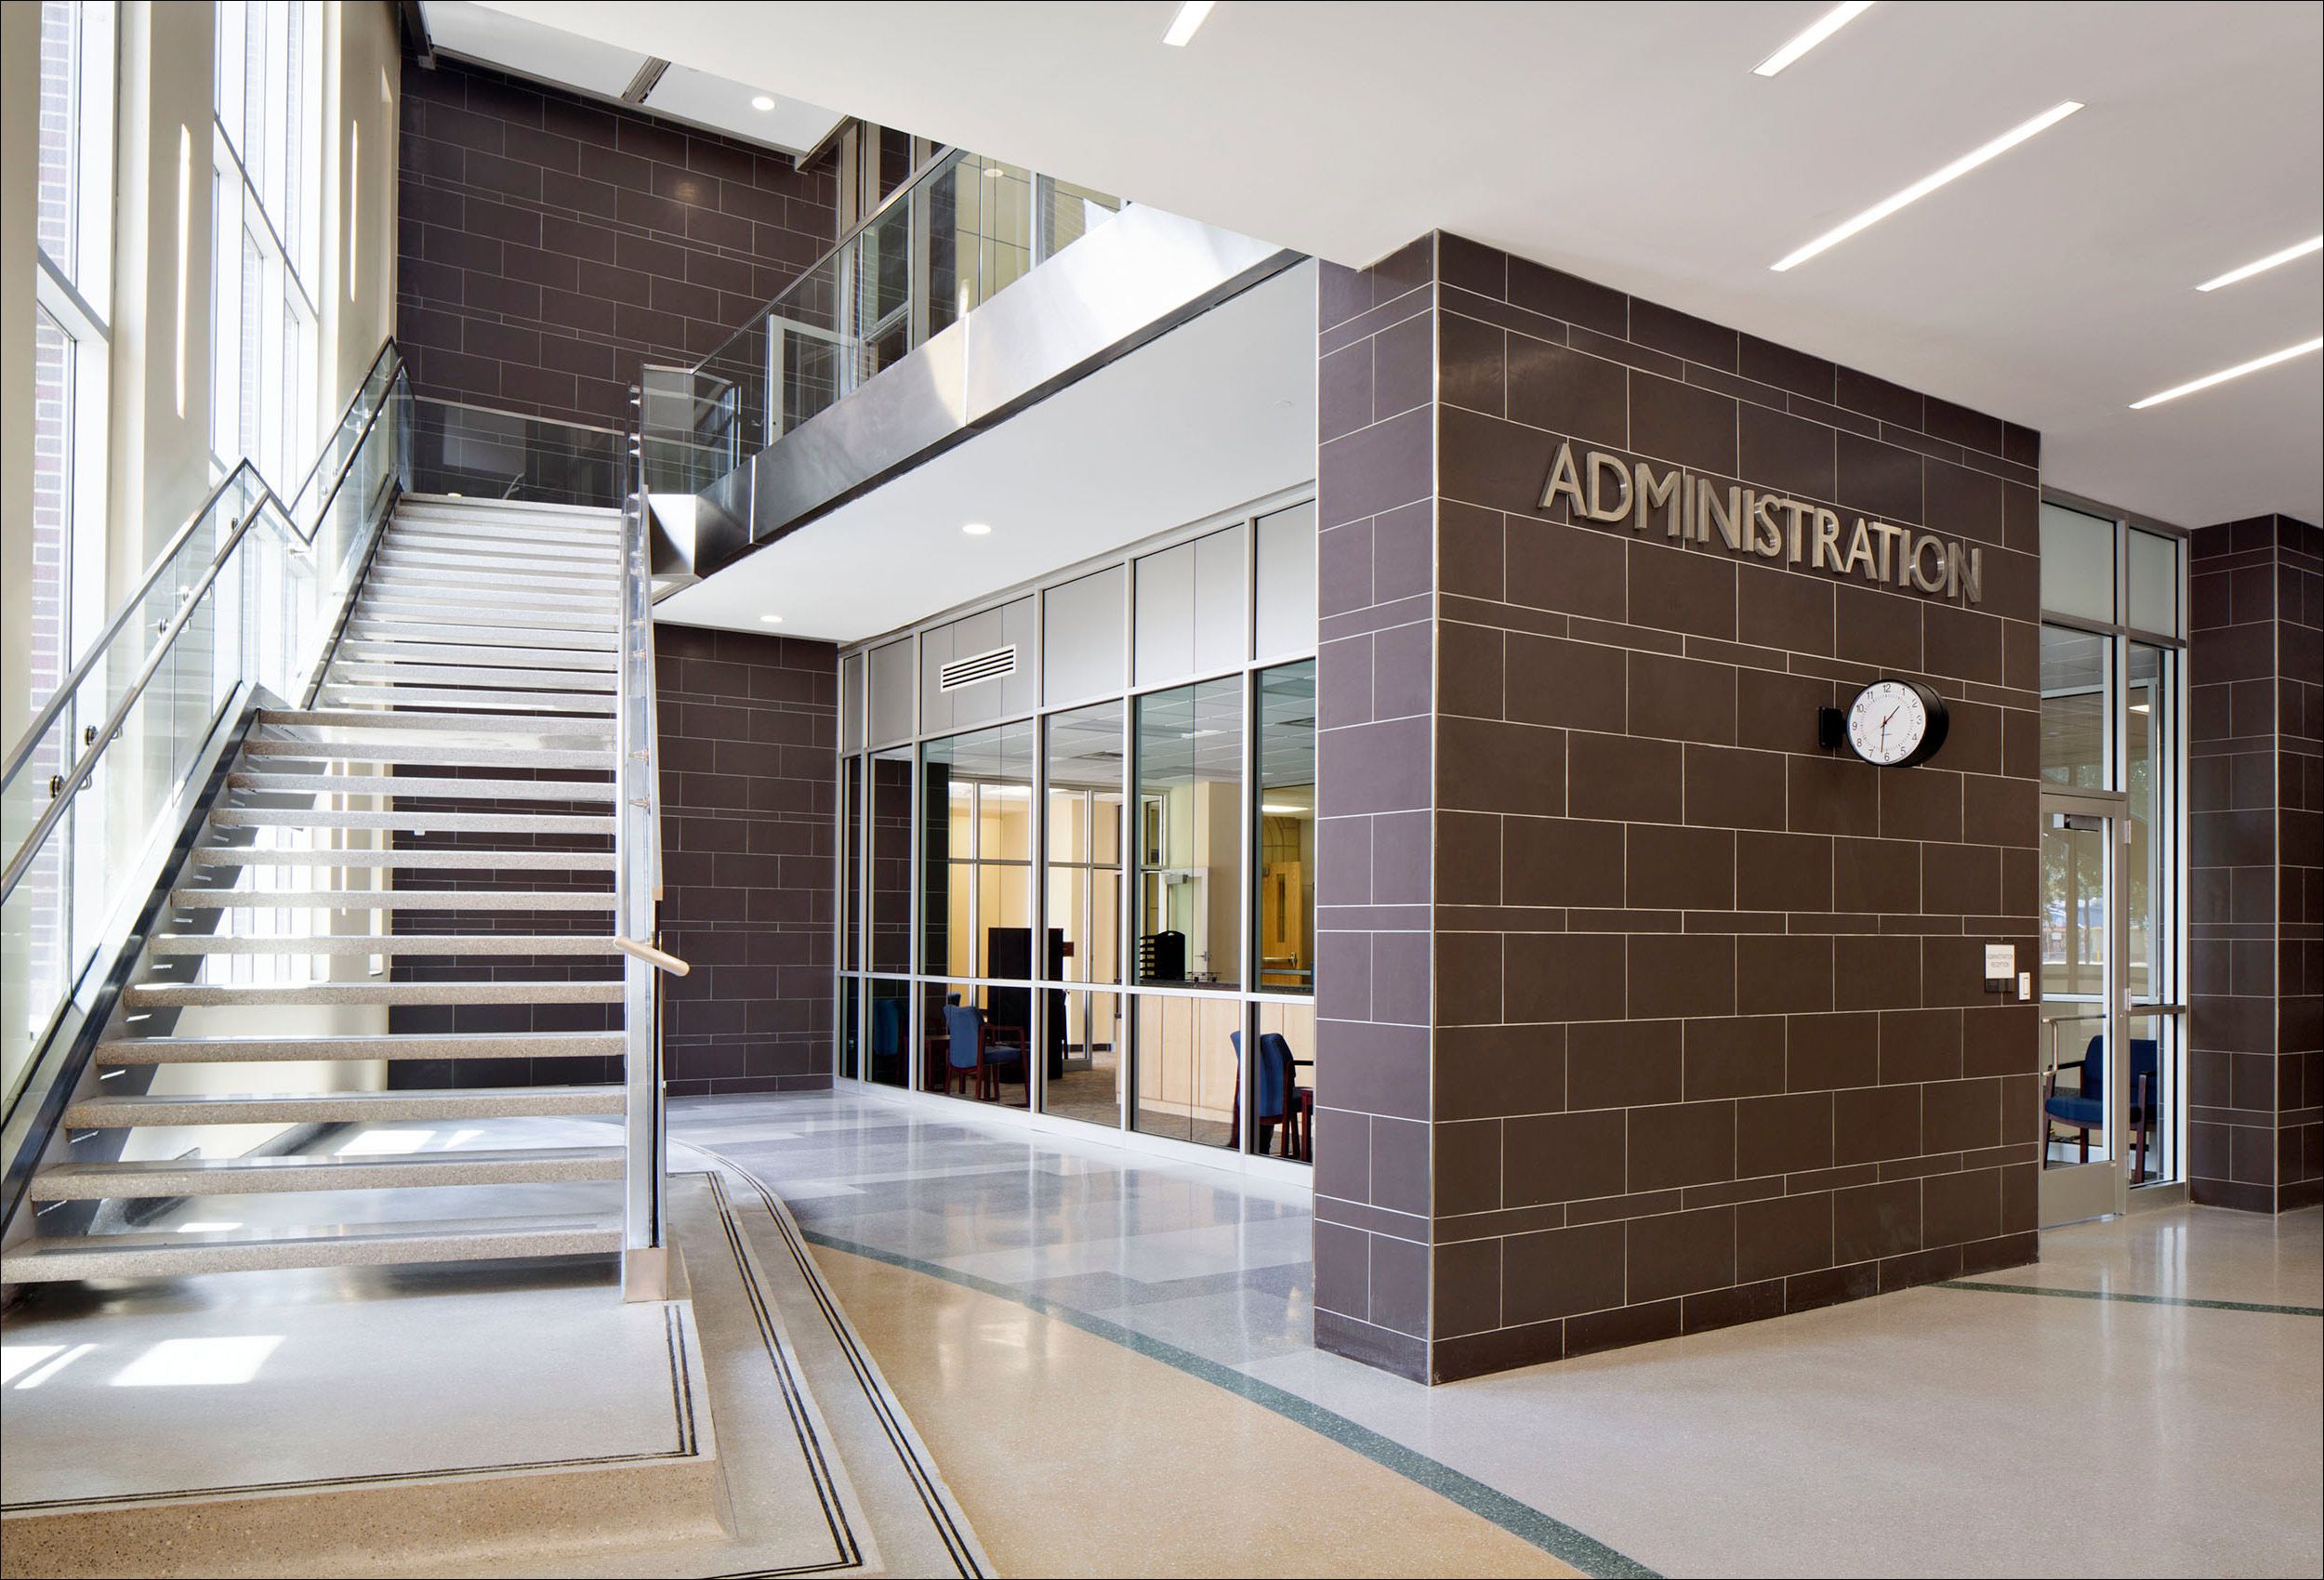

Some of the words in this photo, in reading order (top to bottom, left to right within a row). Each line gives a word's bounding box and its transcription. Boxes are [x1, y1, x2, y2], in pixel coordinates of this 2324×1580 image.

[1538, 441, 1983, 603] ADMINISTRATION
[1882, 683, 1892, 693] 12
[1901, 688, 1906, 696] 1
[1867, 691, 1874, 699] 11
[1855, 703, 1865, 713] 10
[1912, 699, 1919, 708] 2
[1916, 715, 1921, 725] 3
[1852, 721, 1858, 731] 9
[1856, 738, 1863, 747] 8
[1868, 748, 1874, 757] 7
[1900, 746, 1907, 757] 5
[1883, 752, 1890, 762] 6
